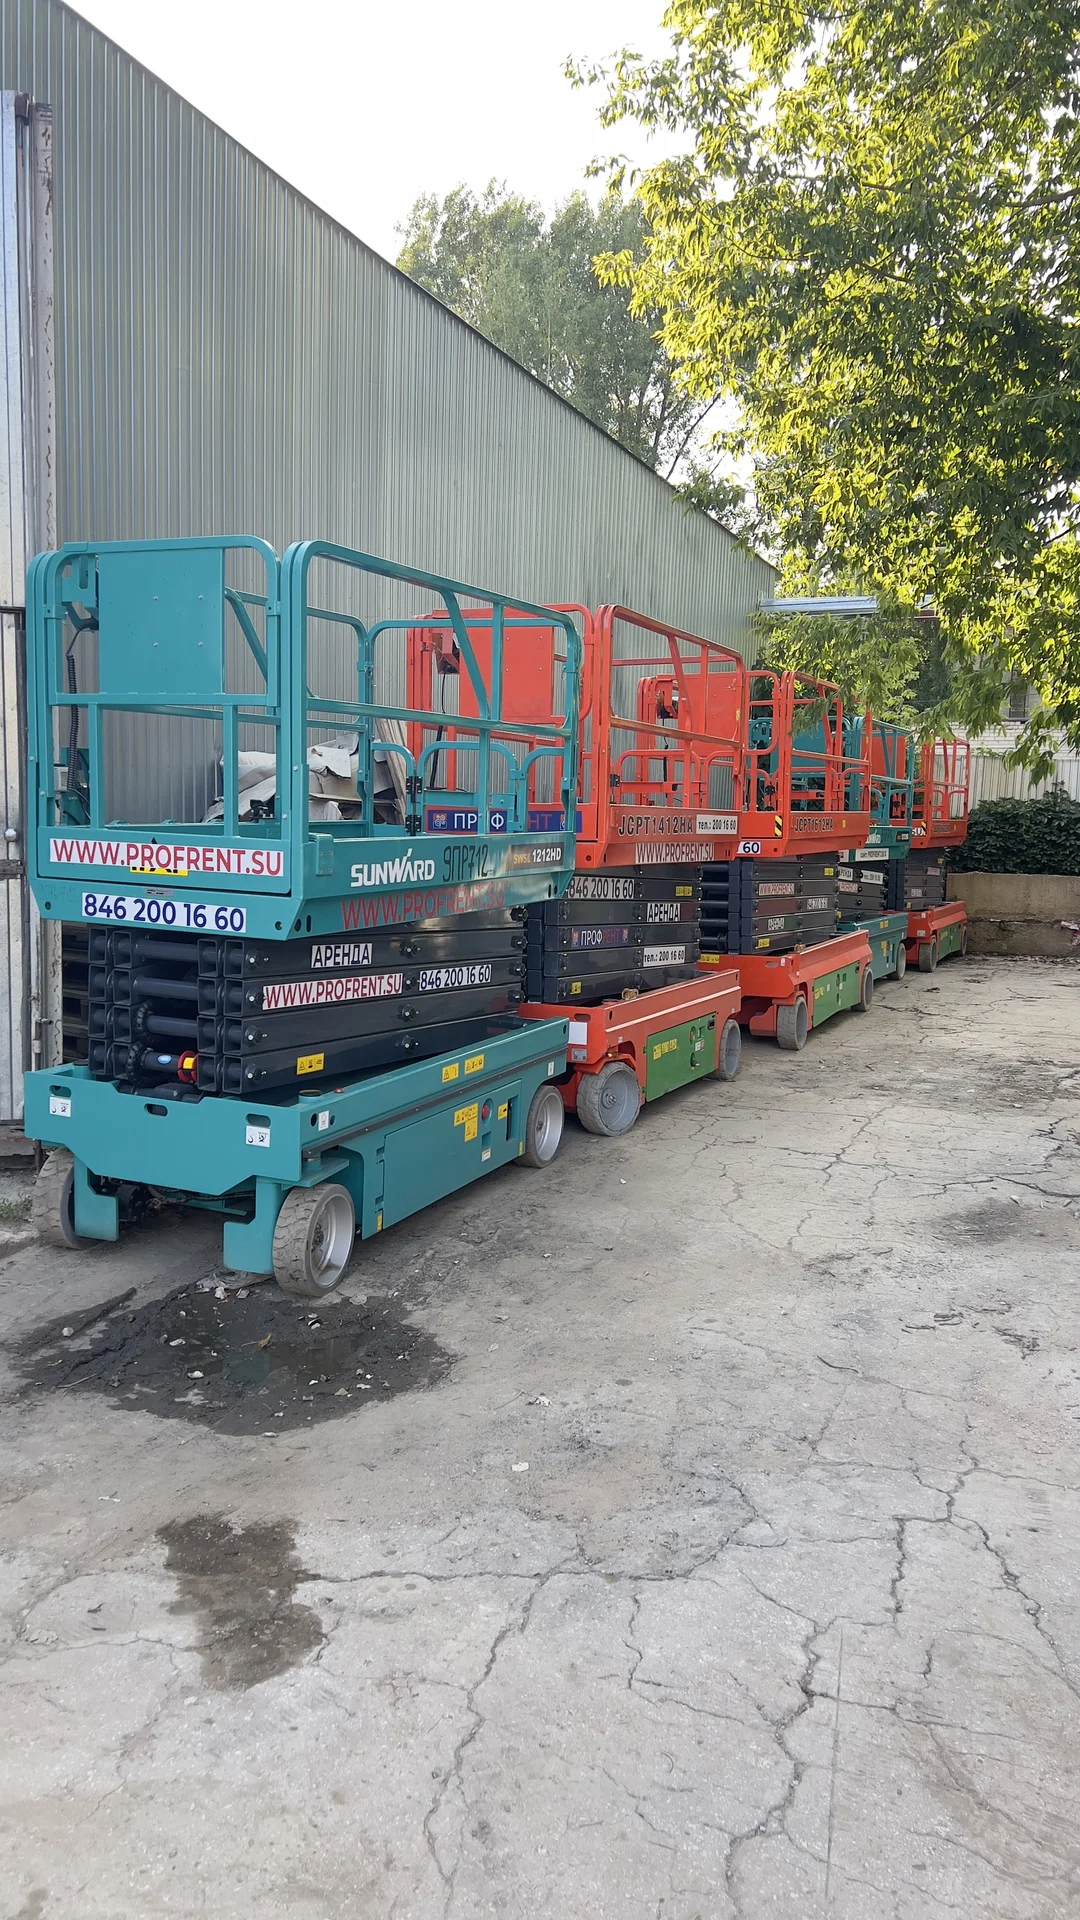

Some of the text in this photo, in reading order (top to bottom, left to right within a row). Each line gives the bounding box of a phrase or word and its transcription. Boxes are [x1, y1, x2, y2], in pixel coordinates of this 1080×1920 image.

[454, 813, 552, 830] ПРФНТ
[712, 819, 723, 831] 200
[723, 819, 730, 830] 16
[730, 819, 736, 830] 60
[54, 839, 281, 876] WWW.PROFRENT.SU
[532, 847, 562, 863] 1212HD
[636, 842, 714, 863] WWW.PROFRENT.SU
[743, 842, 760, 854] 60
[350, 848, 435, 888] SUNWARD
[569, 877, 634, 899] 846 200 16 60
[84, 893, 244, 932] 846 200 16 60
[342, 882, 506, 930] WWW.PROFRENT.SU
[648, 903, 680, 922] АРЕНДА
[313, 944, 370, 967] АРЕНДА
[644, 949, 685, 963] тел.: 200 16 60
[420, 965, 491, 991] 846 200 16 60
[266, 973, 402, 1008] WWW.PROFRENT.SU
